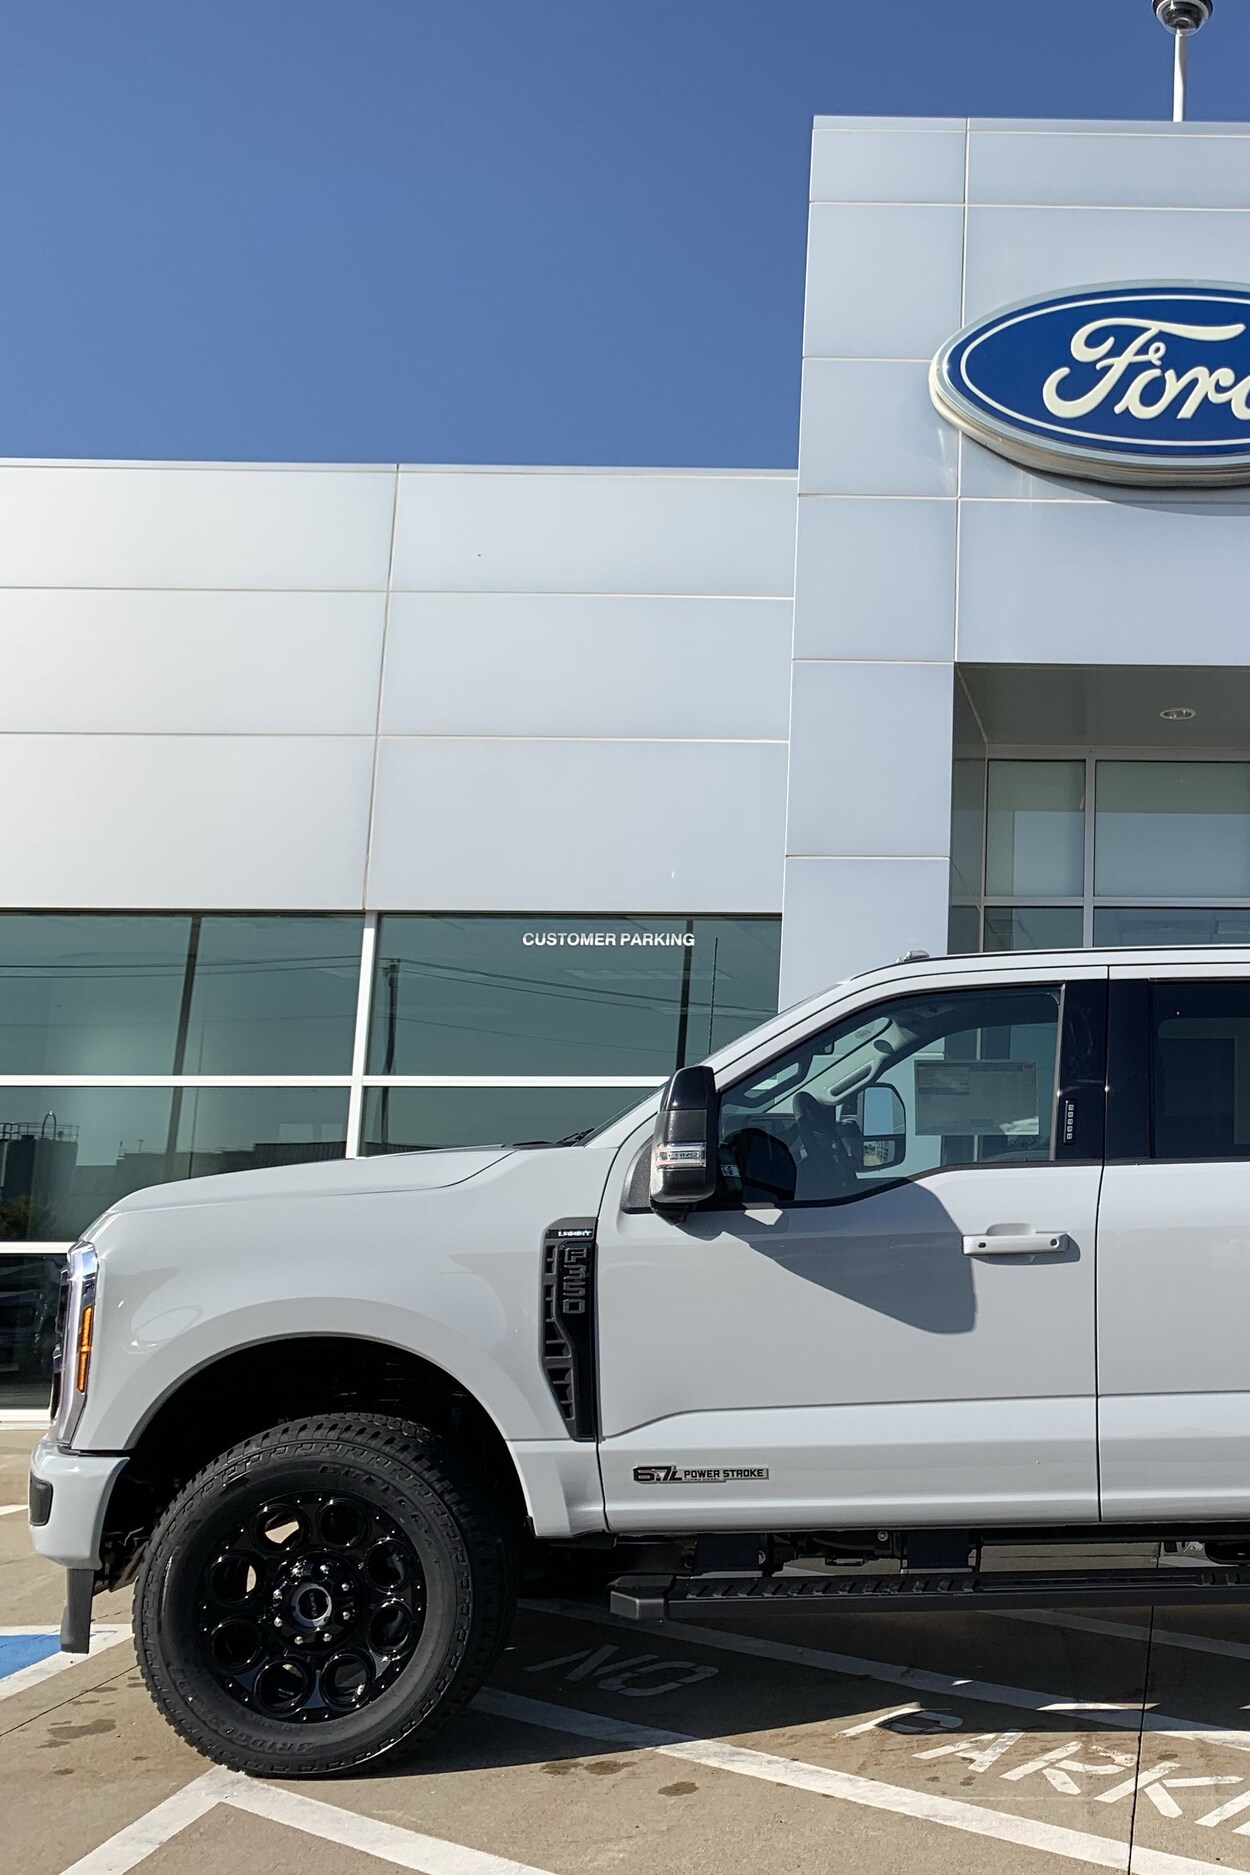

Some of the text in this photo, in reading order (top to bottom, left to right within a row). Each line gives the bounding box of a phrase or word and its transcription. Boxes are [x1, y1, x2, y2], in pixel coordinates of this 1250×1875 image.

[522, 932, 695, 946] CUSTOMER PARKING
[562, 1247, 587, 1314] F350
[633, 1465, 764, 1482] 6.7L POWER STROKE
[522, 1644, 720, 1697] NO
